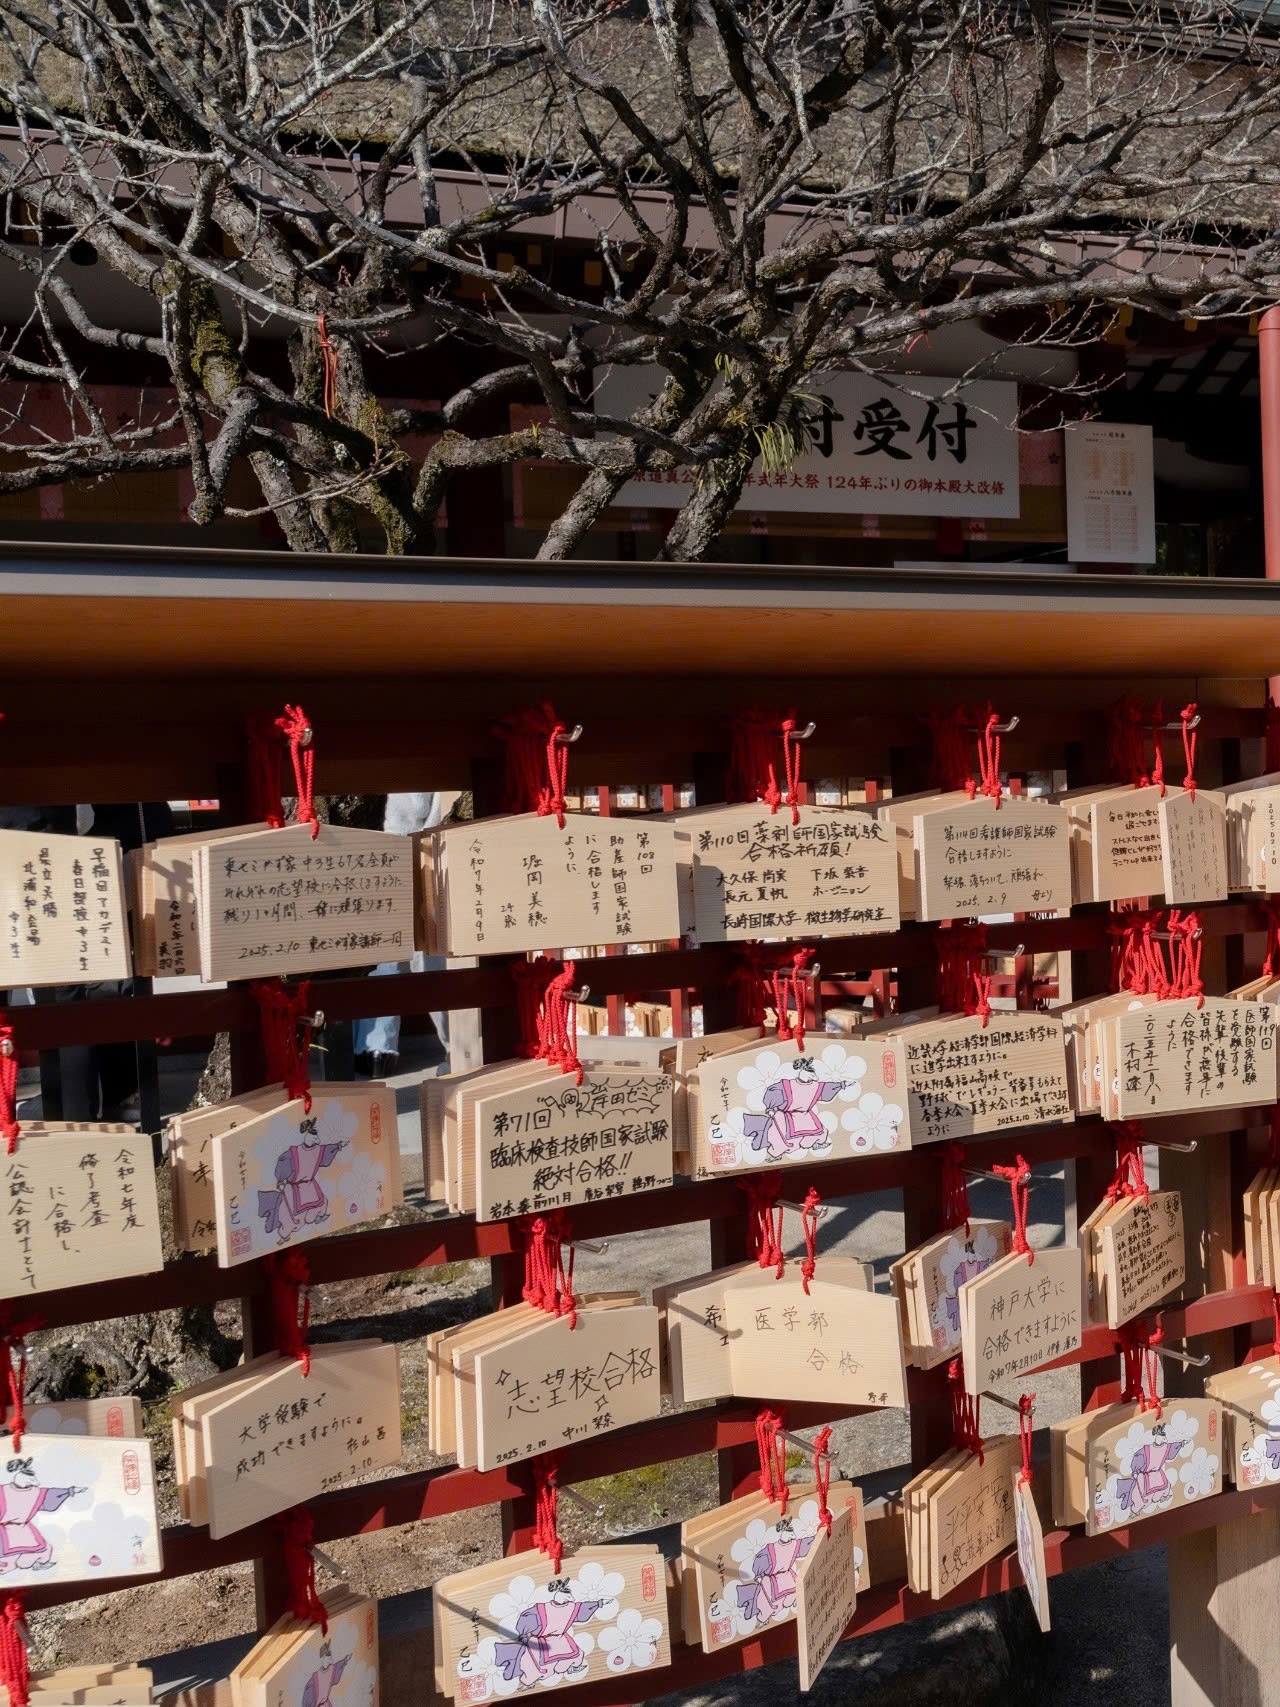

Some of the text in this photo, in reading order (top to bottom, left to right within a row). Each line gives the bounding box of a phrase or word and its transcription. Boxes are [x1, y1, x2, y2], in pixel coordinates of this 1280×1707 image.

[827, 475, 1006, 495] 124年ぶりの御本殿大改修
[636, 832, 655, 875] 第108回
[943, 824, 1058, 842] 第114回看護師国家試験
[946, 845, 1013, 864] 合格しますように
[585, 834, 603, 915] に合格します
[609, 835, 633, 936] 助産師国家試験
[89, 848, 112, 957] 早稲田アカデミー
[720, 907, 893, 930] 長崎国際大学 微生物学研究室
[1165, 1018, 1178, 1052] ように
[1180, 1011, 1199, 1096] 合格できます
[1228, 1008, 1243, 1077] を受験する
[1242, 1009, 1258, 1086] 医師国家試験
[1258, 1006, 1276, 1051] 第119回
[1197, 1011, 1213, 1099] 皆様が無事に
[493, 1108, 552, 1137] 第71回
[590, 1084, 651, 1110] 岸田ゼミ
[490, 1119, 669, 1170] 臨床検査技師国家試験
[114, 1148, 145, 1233] 令和七年度
[6, 1163, 37, 1290] 公認会計士として
[755, 1306, 829, 1338] 医学部
[989, 1275, 1066, 1322] 神戸大学に
[982, 1309, 1077, 1361] 合格できますように
[506, 1347, 658, 1420] 志望校合格
[806, 1347, 864, 1376] 合格
[987, 1349, 1043, 1384] 令和7年2月10日
[238, 1392, 328, 1446] 大学受験で
[233, 1416, 363, 1483] 成功できますように。
